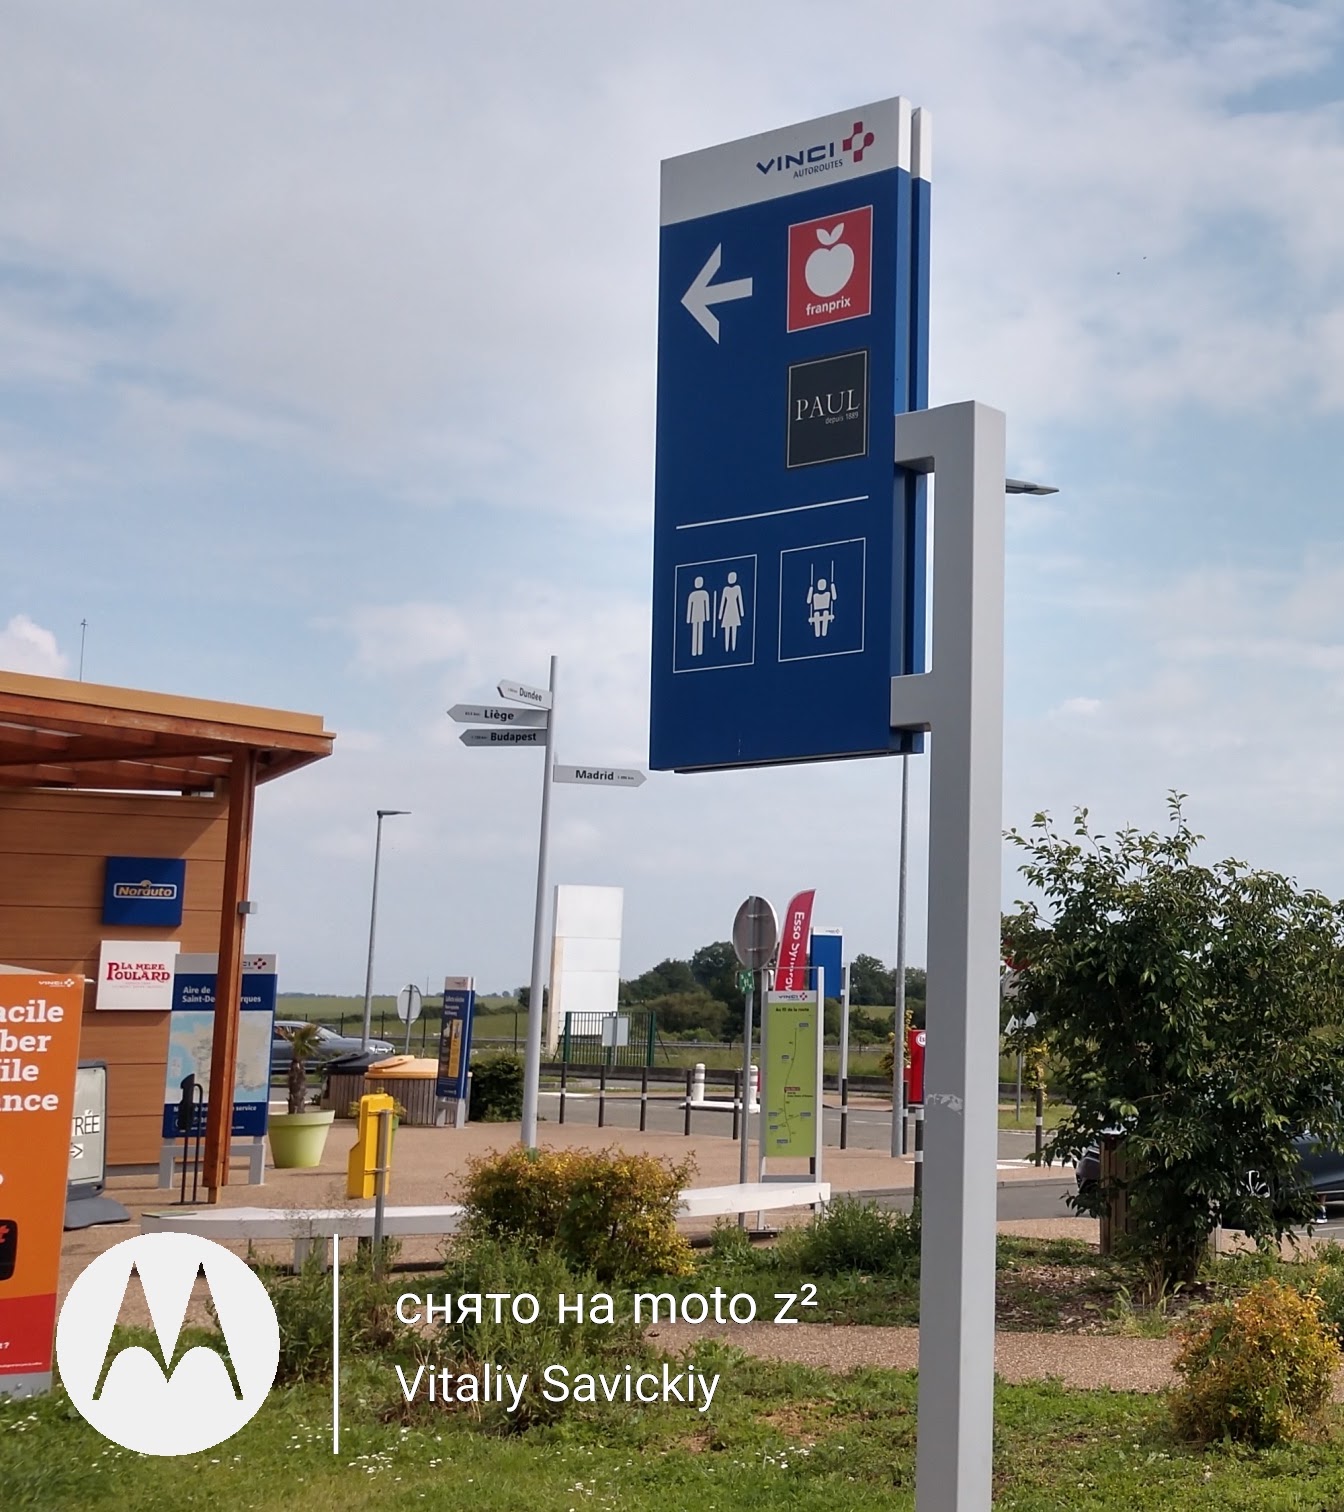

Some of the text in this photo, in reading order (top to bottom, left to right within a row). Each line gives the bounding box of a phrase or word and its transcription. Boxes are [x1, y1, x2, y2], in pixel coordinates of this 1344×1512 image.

[756, 142, 834, 175] VINCI
[793, 159, 843, 179] AUTOROUTES
[806, 296, 851, 316] franprix
[795, 389, 860, 421] PAUL
[845, 411, 859, 420] 1889
[519, 687, 543, 702] Dundee
[484, 709, 514, 722] Liège
[490, 732, 537, 743] Budapest
[575, 769, 614, 780] Madrid
[118, 886, 173, 897] Norauto
[793, 911, 805, 940] Esso
[106, 962, 170, 983] POULARD
[121, 962, 133, 970] LA
[183, 986, 211, 994] Aire de
[0, 1058, 39, 1082] ile
[0, 1094, 59, 1112] nce
